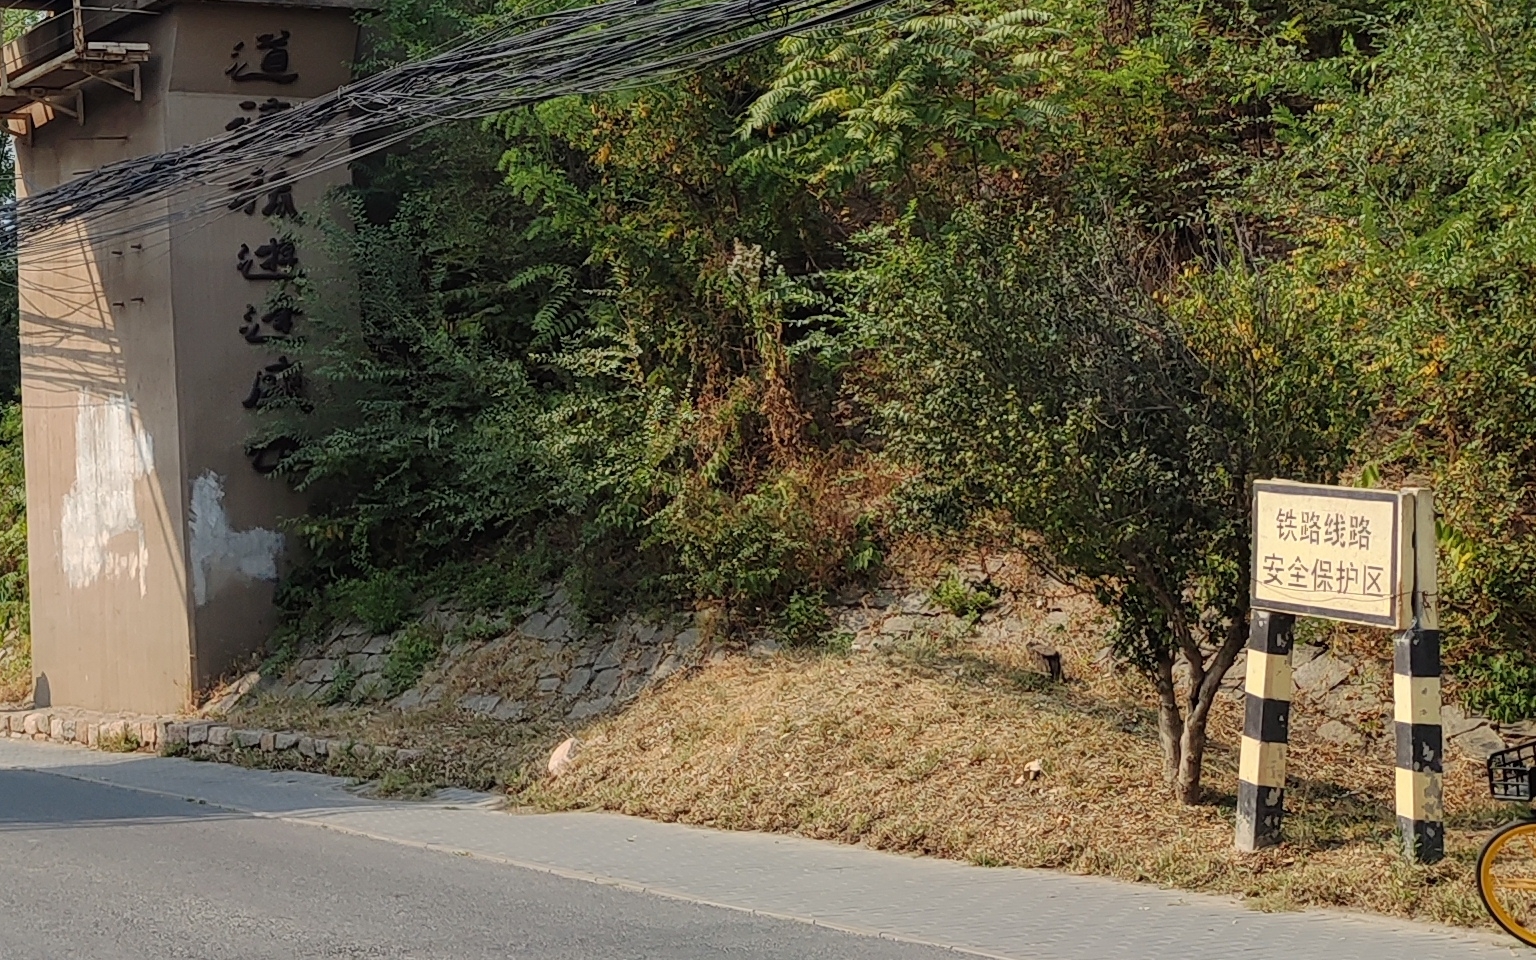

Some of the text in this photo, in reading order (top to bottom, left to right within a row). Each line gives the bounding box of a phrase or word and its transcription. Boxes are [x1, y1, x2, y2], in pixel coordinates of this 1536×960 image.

[1275, 507, 1372, 550] 铁路线路
[1262, 553, 1385, 596] 安全保护区
